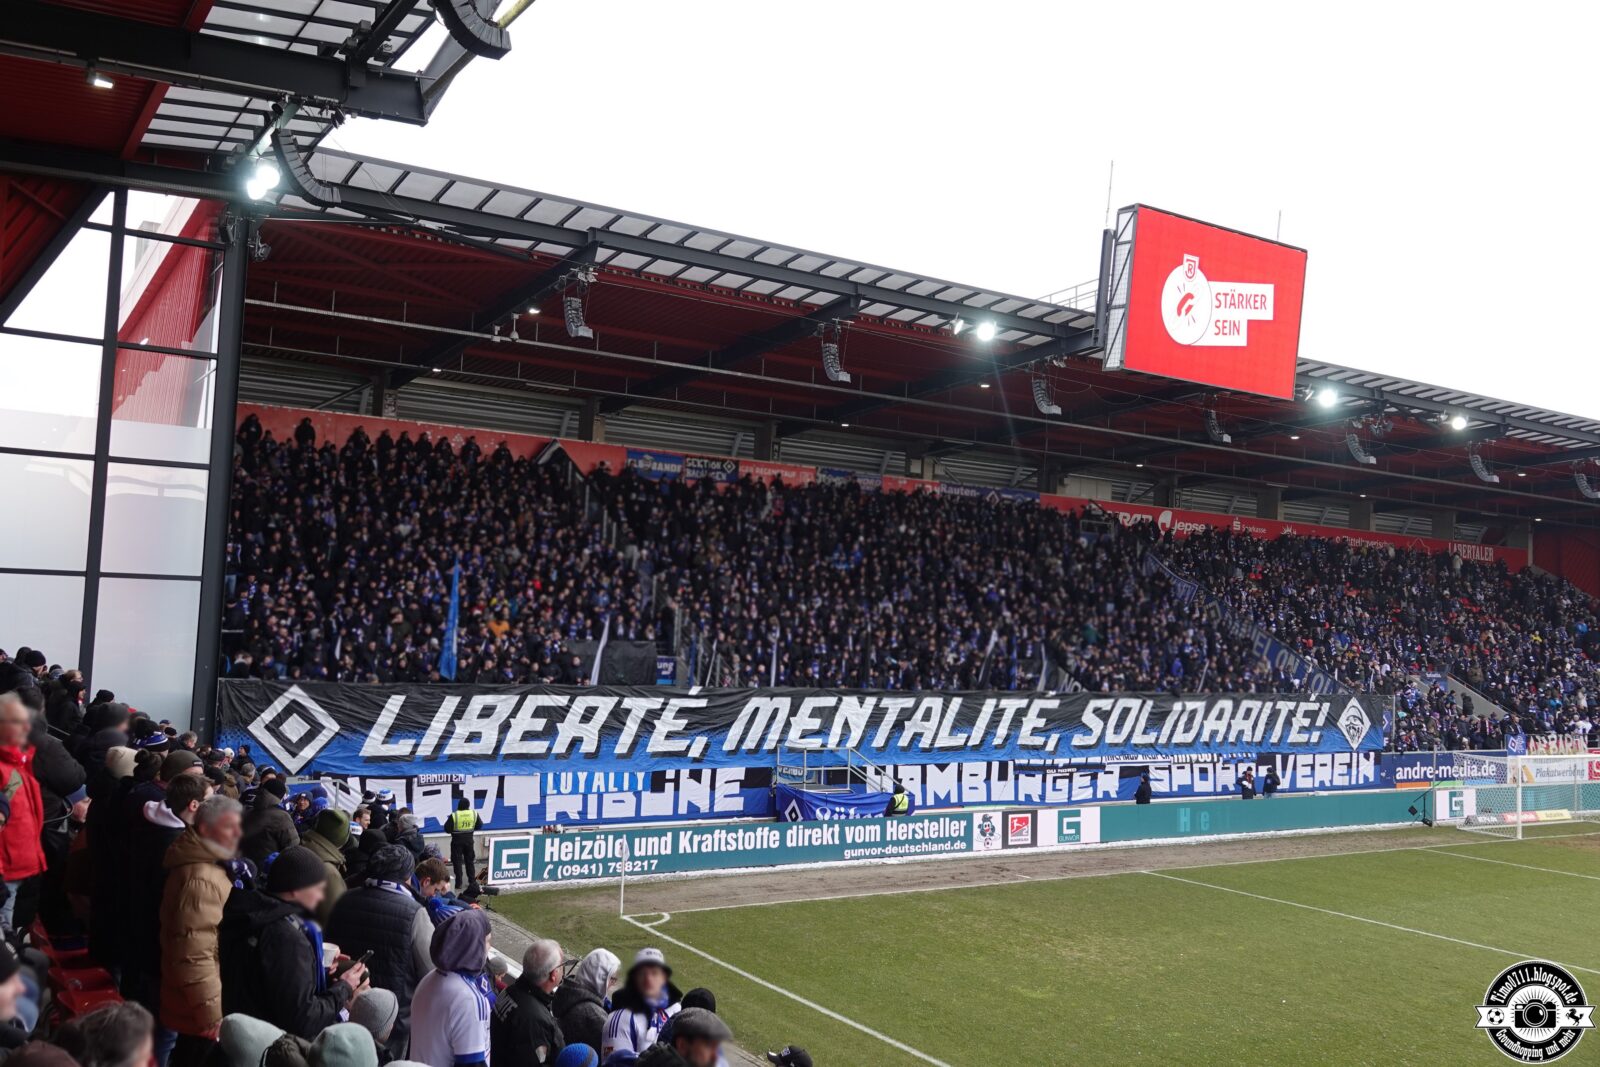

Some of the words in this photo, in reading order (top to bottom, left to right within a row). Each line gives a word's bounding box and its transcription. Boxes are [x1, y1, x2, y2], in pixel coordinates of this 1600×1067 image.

[1215, 289, 1267, 311] STÄRKER
[1214, 320, 1241, 336] SEIN
[359, 686, 708, 757] LIBERTÉ,
[1071, 692, 1330, 746] SOLIDARITÉ!
[1395, 761, 1497, 780] andre-media.de
[866, 758, 1120, 806] HAMBURGER
[634, 831, 673, 857] und
[679, 825, 780, 854] Kraftstoffe
[786, 819, 840, 847] direkt
[845, 818, 881, 843] vom
[886, 817, 967, 840] Hersteller
[844, 841, 967, 859] gunvor-deutschland.de
[493, 868, 527, 880] GUNVOR
[557, 863, 603, 880] (0941)
[608, 859, 658, 874] 798217
